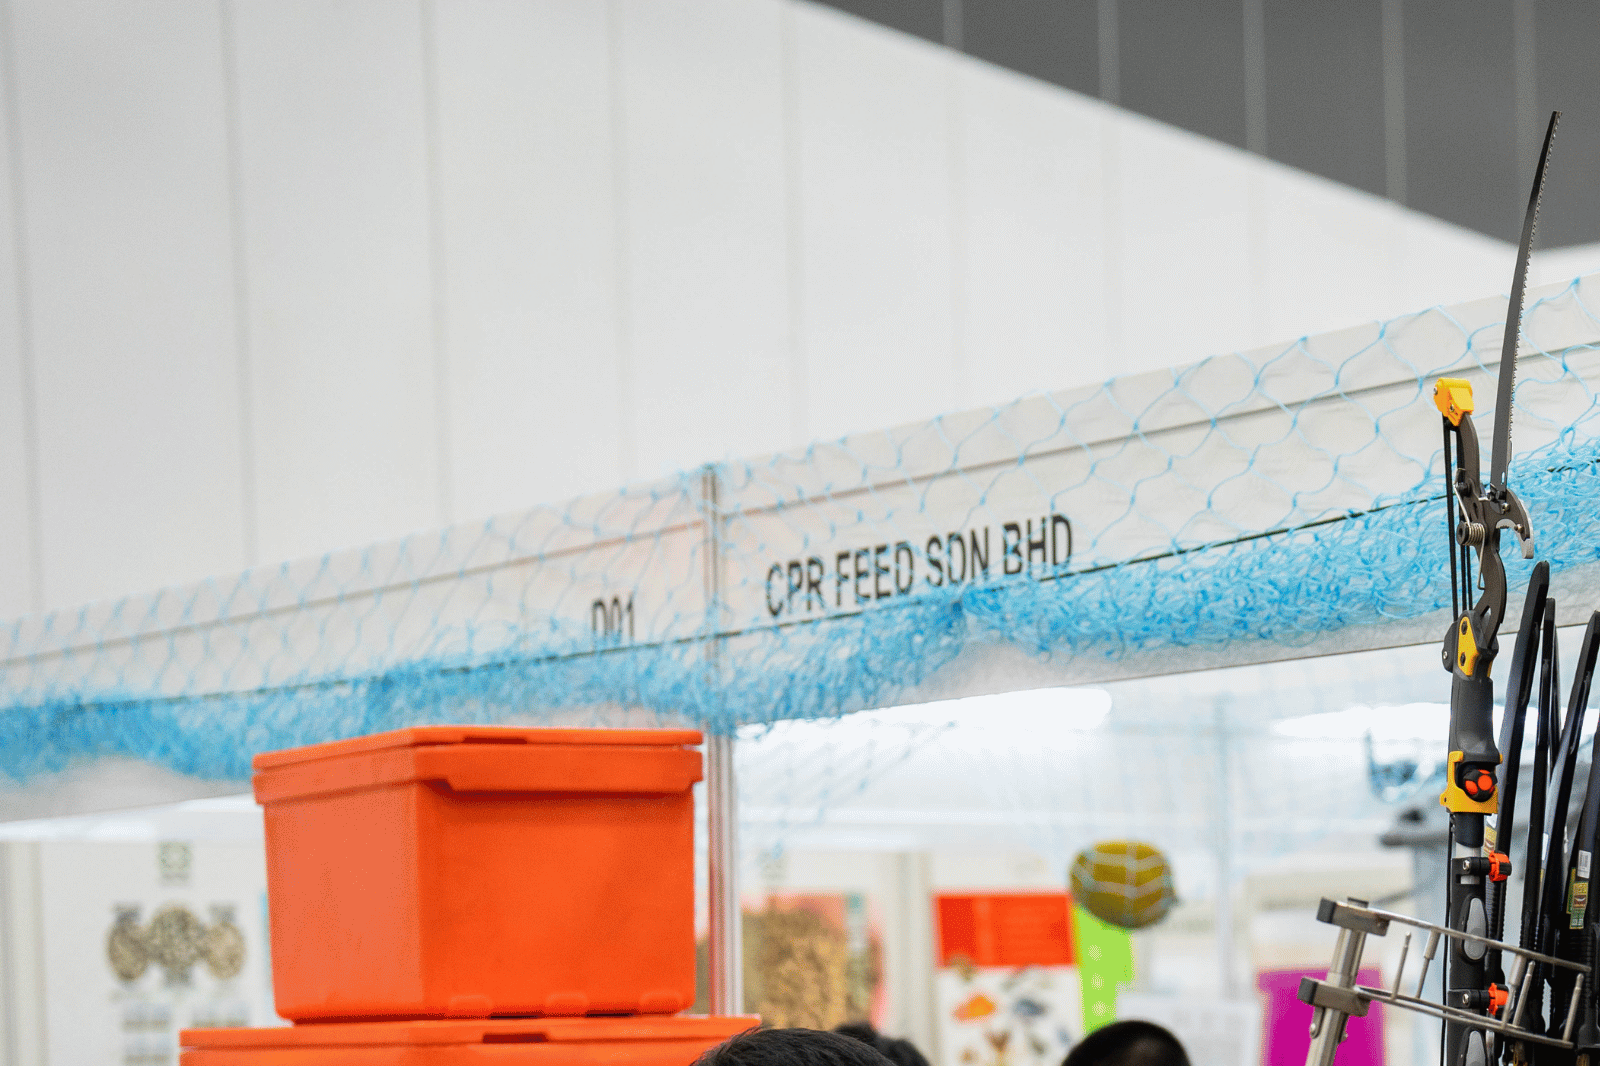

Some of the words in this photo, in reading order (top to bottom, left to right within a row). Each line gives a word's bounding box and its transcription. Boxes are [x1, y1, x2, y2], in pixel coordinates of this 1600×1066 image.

[765, 555, 825, 618] CPR
[835, 540, 914, 606] FEED
[926, 526, 989, 587] SDN
[1003, 513, 1073, 580] BHD
